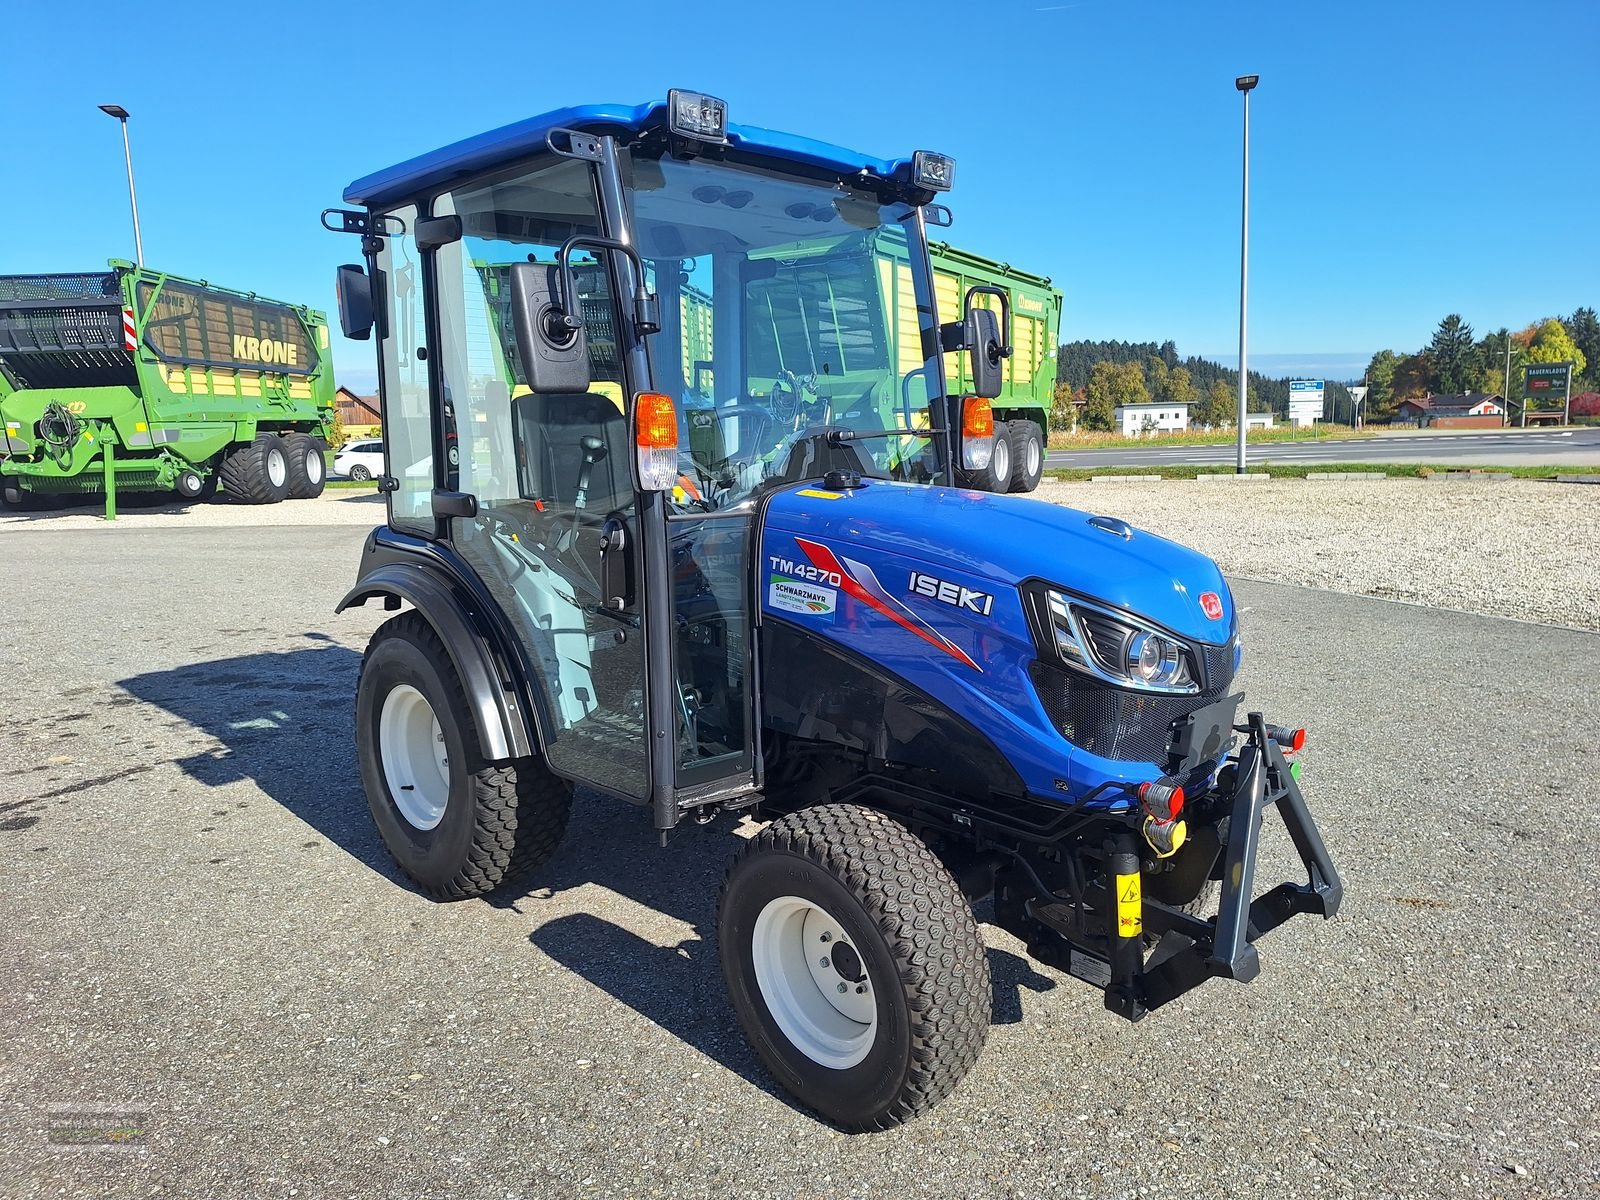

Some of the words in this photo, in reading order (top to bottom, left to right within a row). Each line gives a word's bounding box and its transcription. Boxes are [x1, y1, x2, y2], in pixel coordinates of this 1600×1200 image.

[156, 293, 184, 308] RONE
[233, 334, 297, 366] KRONE
[1528, 367, 1567, 375] BAUERNLADEN
[769, 555, 842, 588] TM4270
[775, 583, 827, 604] SCHWARZMAYR
[775, 591, 805, 604] LANDTECHNIK
[908, 570, 994, 617] ISEKI
